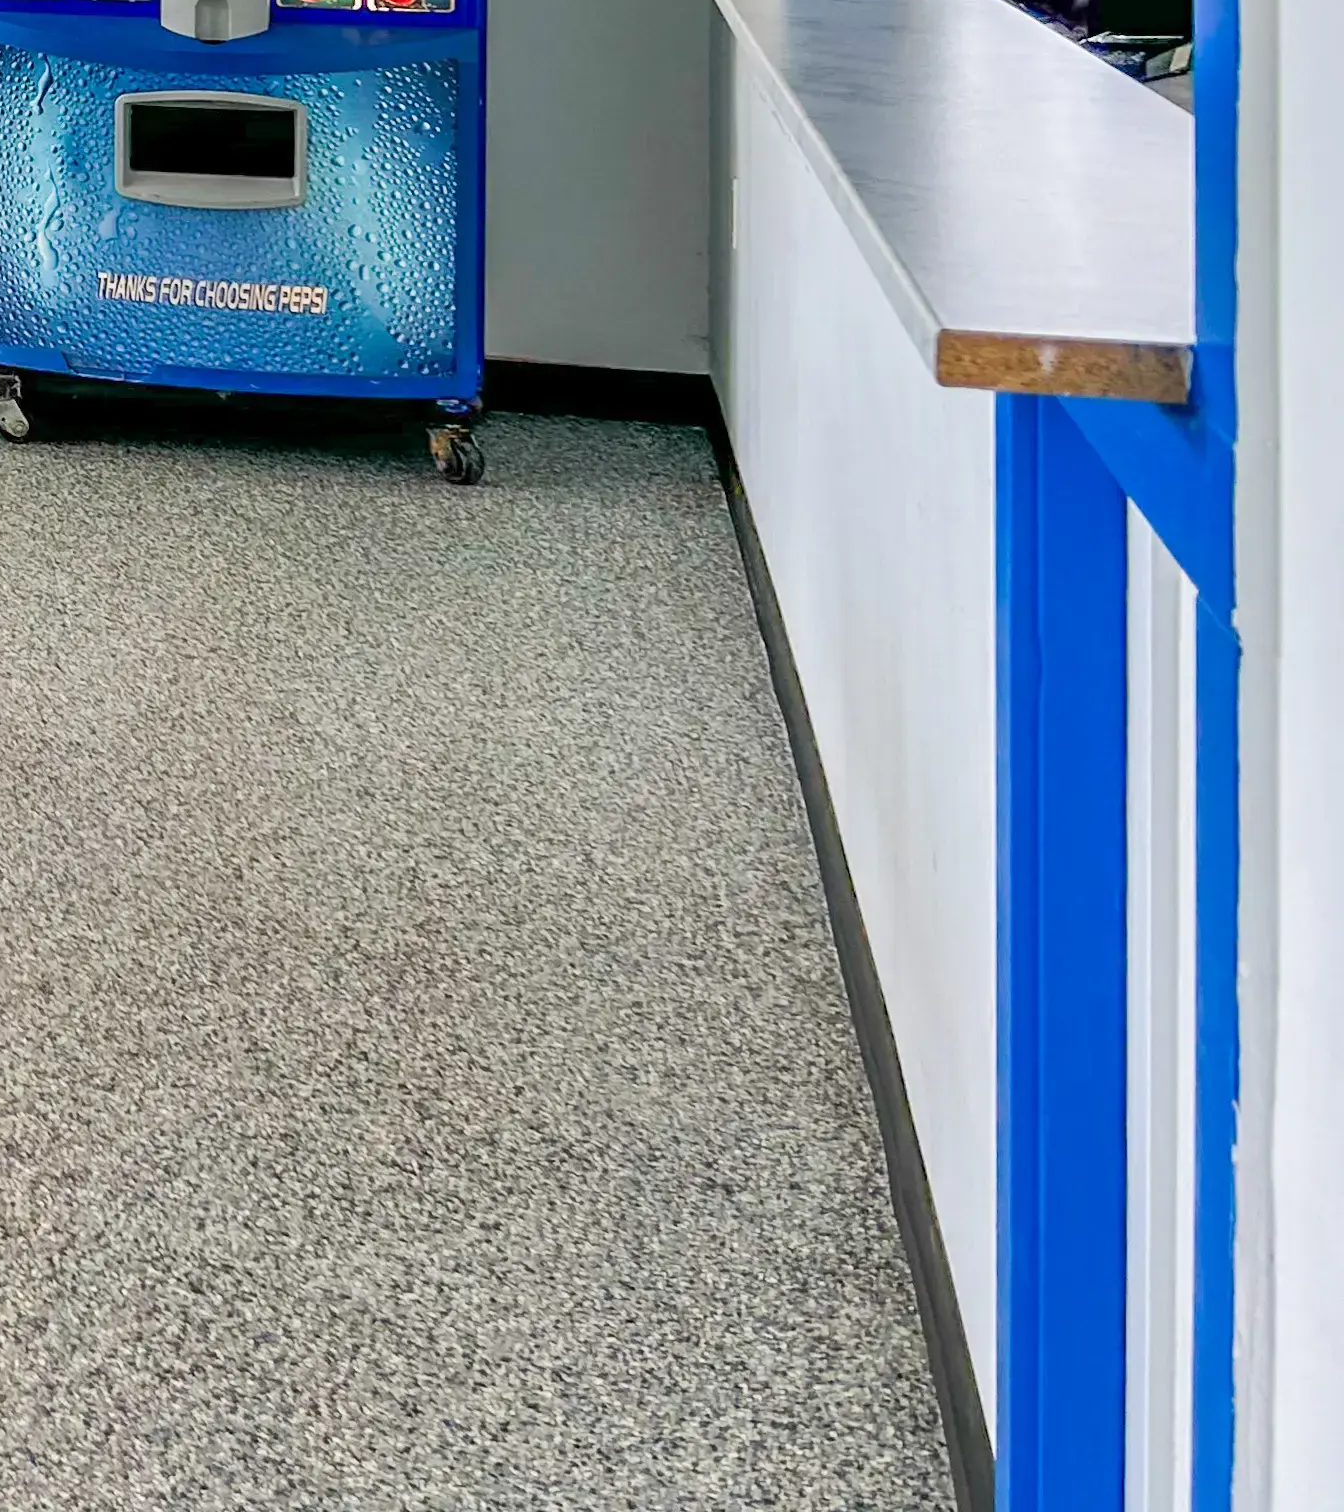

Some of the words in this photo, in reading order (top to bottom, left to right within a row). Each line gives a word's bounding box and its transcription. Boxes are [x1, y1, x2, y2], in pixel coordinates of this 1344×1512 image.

[97, 271, 157, 304] THANKS
[159, 276, 193, 306] FOR
[194, 280, 275, 312] CHOOSING
[277, 284, 328, 315] PEPSI
